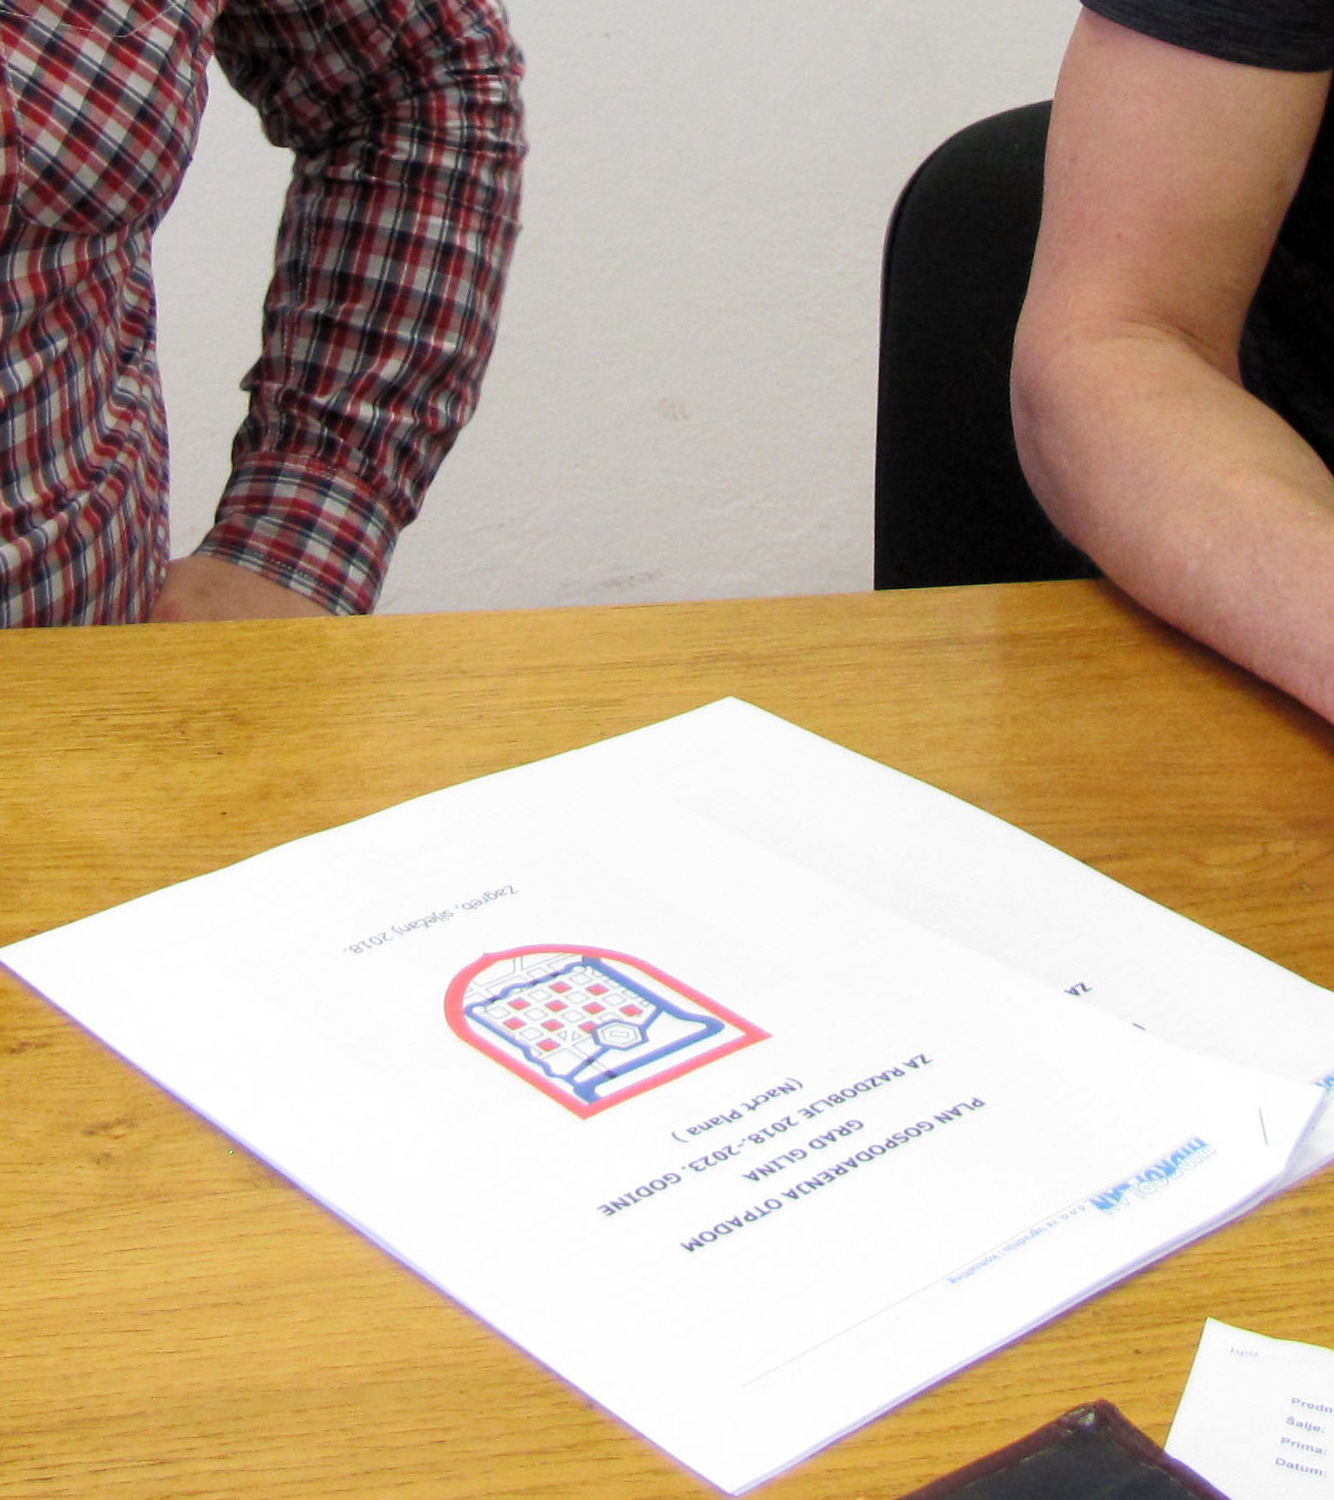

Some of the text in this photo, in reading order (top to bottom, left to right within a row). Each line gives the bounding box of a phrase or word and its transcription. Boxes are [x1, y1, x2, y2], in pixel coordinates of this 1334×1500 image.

[454, 885, 520, 912] Zagreb,
[343, 932, 394, 955] 2018.
[1064, 982, 1093, 997] ZA
[741, 1077, 804, 1112] (Nacrt
[597, 1053, 933, 1217] ZA RAZDOBLJE 2018.-2023. GODINE
[686, 1107, 743, 1137] Plana
[741, 1118, 865, 1183] GRAD GLINA
[679, 1097, 986, 1253] PLAN GOSPODARENJA OTPADOM
[1285, 1414, 1327, 1435] Šalje:
[1280, 1436, 1329, 1457] Prima:
[1274, 1456, 1329, 1478] Datum:
